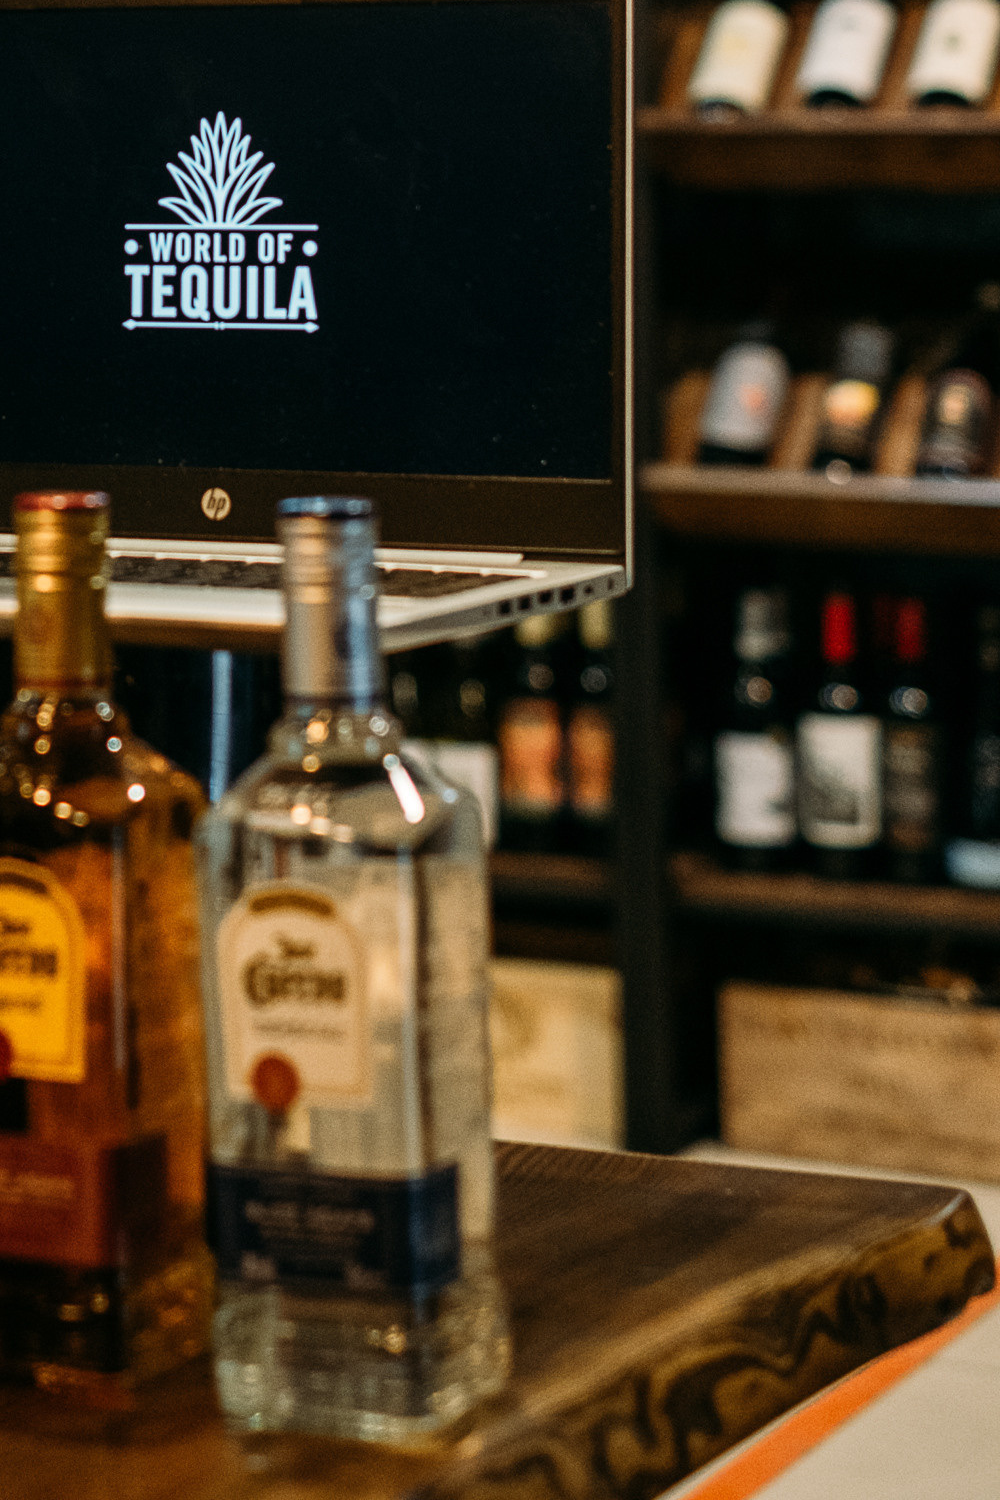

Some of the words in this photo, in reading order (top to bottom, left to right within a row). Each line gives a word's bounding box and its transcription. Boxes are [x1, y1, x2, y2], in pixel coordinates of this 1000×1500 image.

[149, 232, 246, 263] WORLD
[257, 232, 294, 264] OF
[124, 264, 318, 321] TEQUILA
[206, 488, 226, 519] hp
